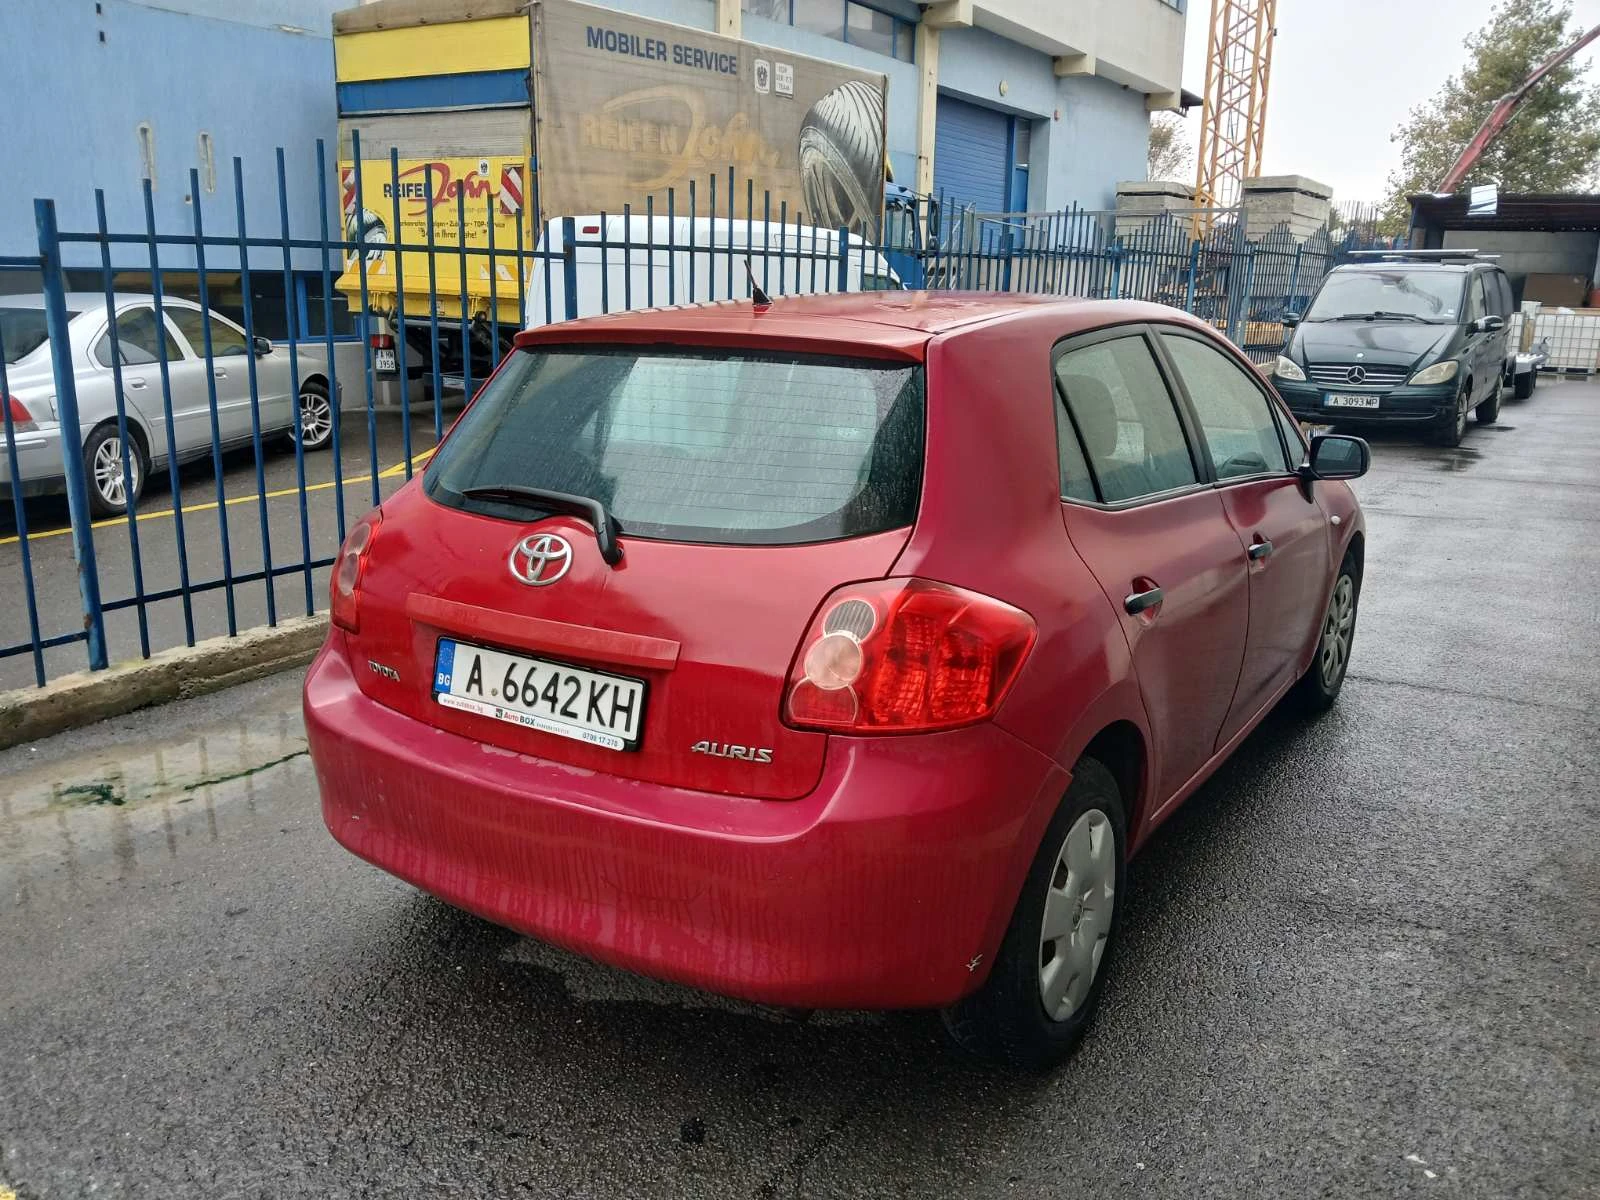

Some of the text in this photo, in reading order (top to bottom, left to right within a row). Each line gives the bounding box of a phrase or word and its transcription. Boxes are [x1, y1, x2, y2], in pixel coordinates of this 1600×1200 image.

[586, 25, 737, 75] MOBILER SERVICE
[1342, 397, 1364, 407] 3093
[367, 659, 401, 683] TOYOTA
[438, 673, 451, 687] BG
[519, 715, 536, 726] BOX
[690, 740, 774, 764] AURIS
